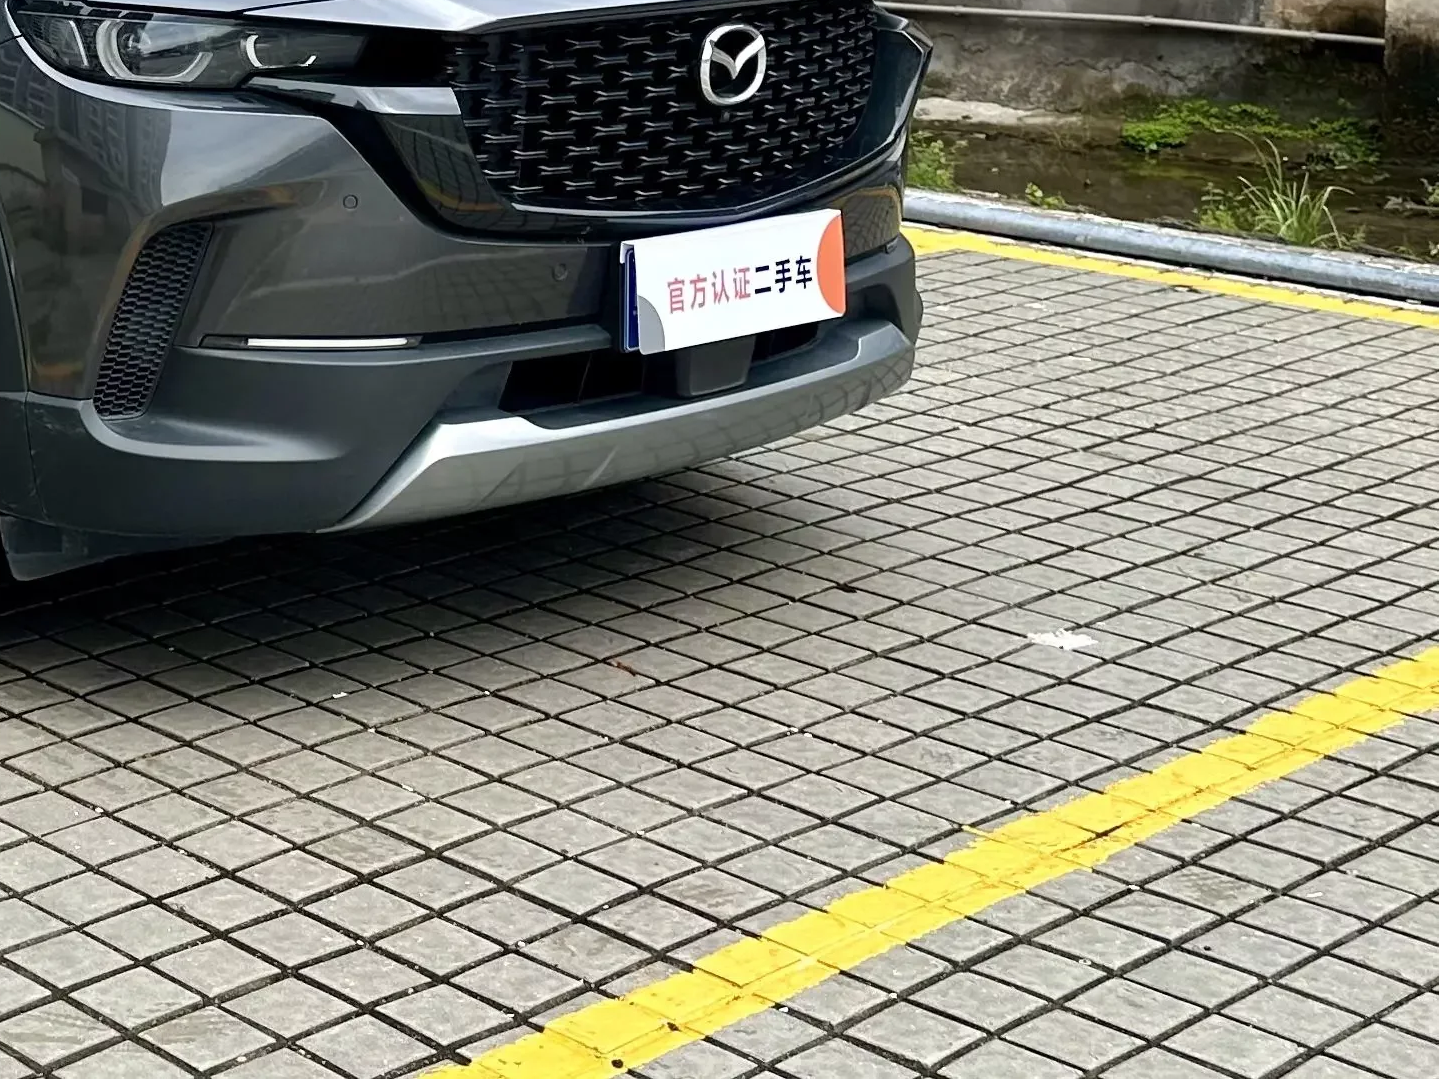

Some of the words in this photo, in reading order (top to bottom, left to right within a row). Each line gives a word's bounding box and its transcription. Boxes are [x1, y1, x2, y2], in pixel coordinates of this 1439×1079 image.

[667, 255, 813, 314] 官方认证二手车
